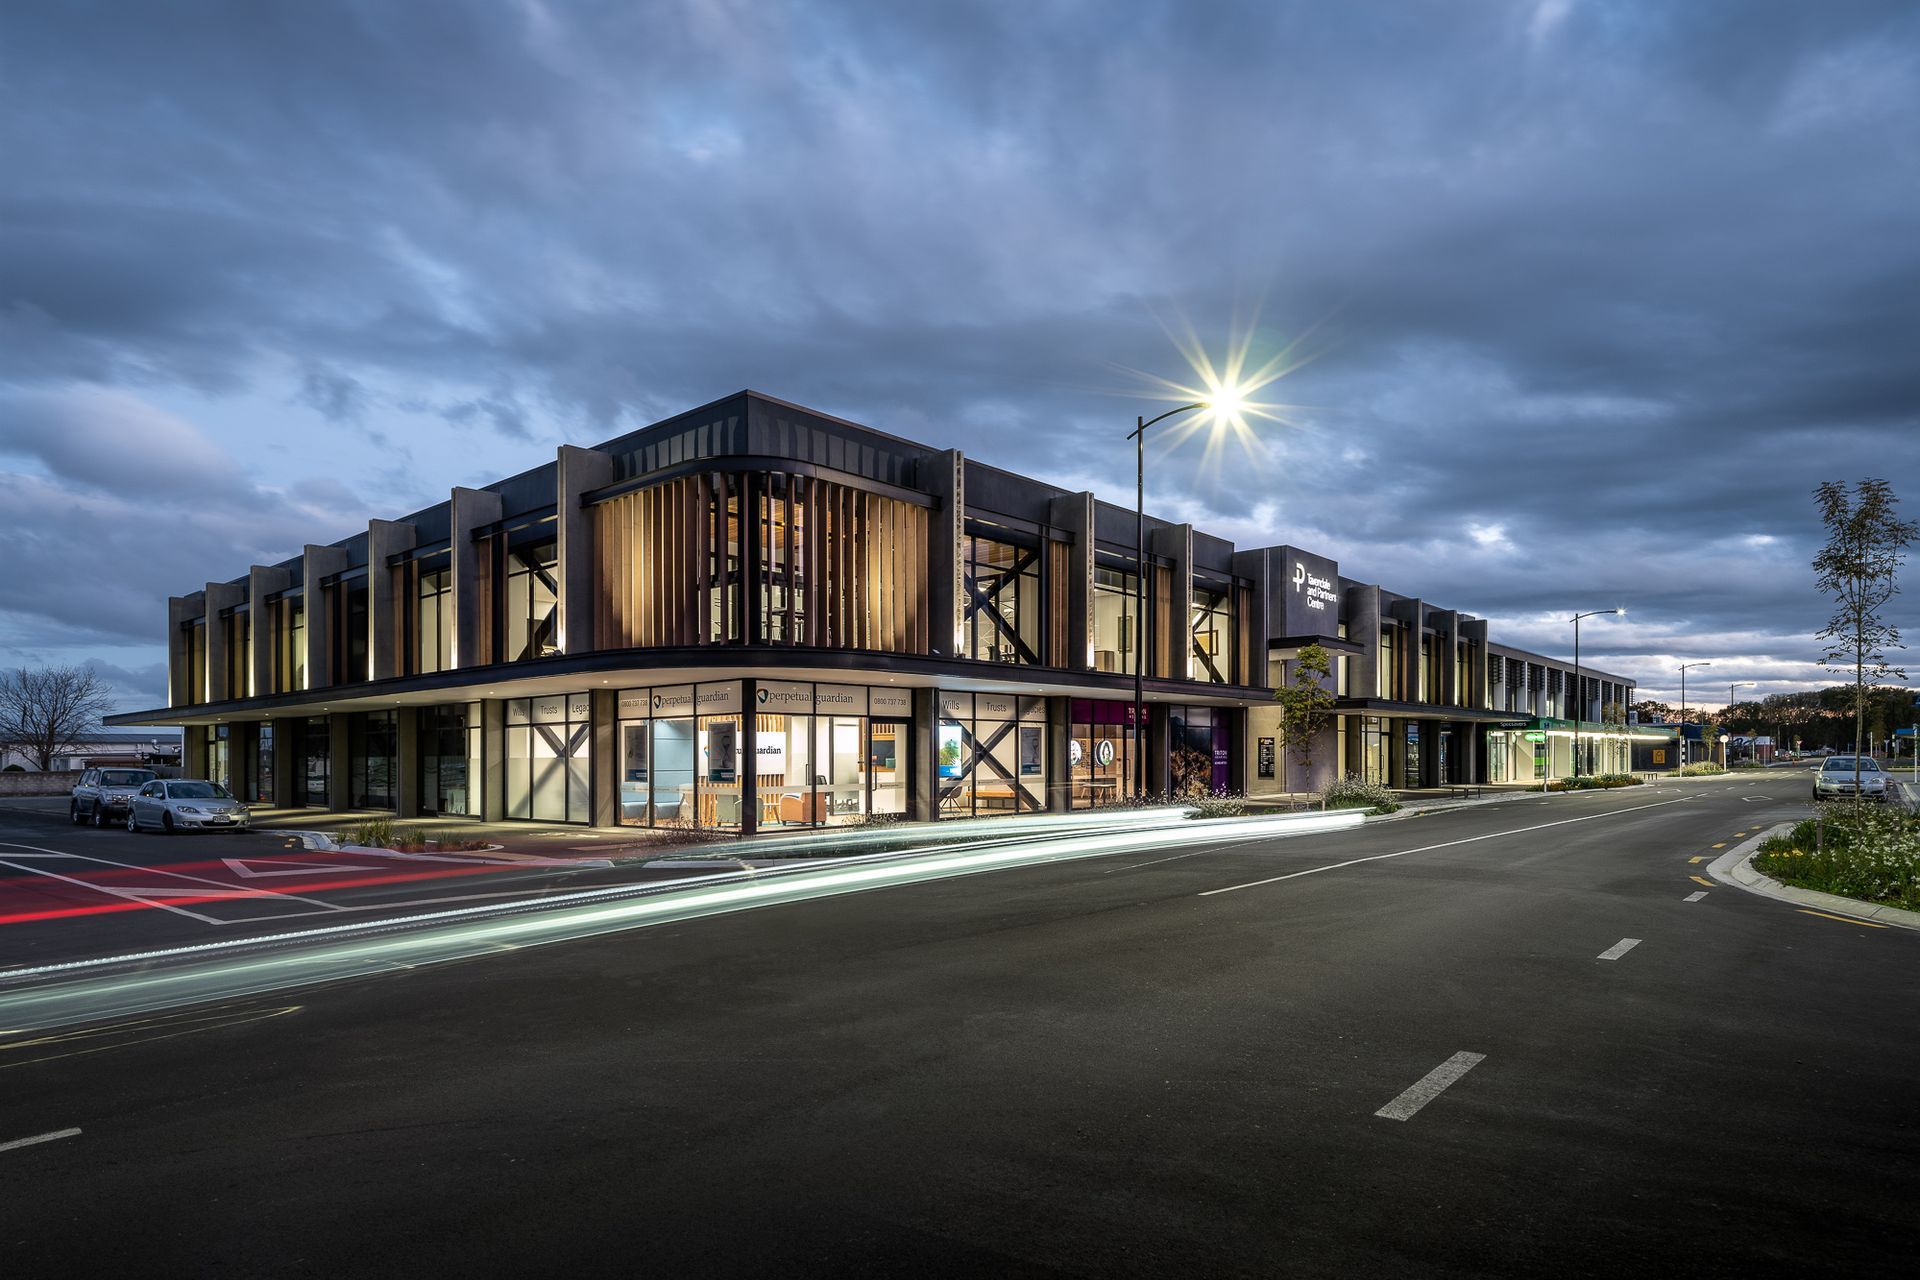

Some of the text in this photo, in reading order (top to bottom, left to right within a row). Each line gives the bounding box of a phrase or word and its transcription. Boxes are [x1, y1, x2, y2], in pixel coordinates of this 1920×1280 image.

[1307, 596, 1324, 610] Centre
[661, 692, 694, 708] perpetual
[696, 690, 729, 706] guardian
[769, 690, 813, 704] perpetual
[815, 692, 853, 705] guardian
[873, 697, 907, 706] 0800 737 738
[540, 705, 558, 715] Trusts
[942, 700, 960, 711] Wills
[985, 702, 1007, 713] Trusts
